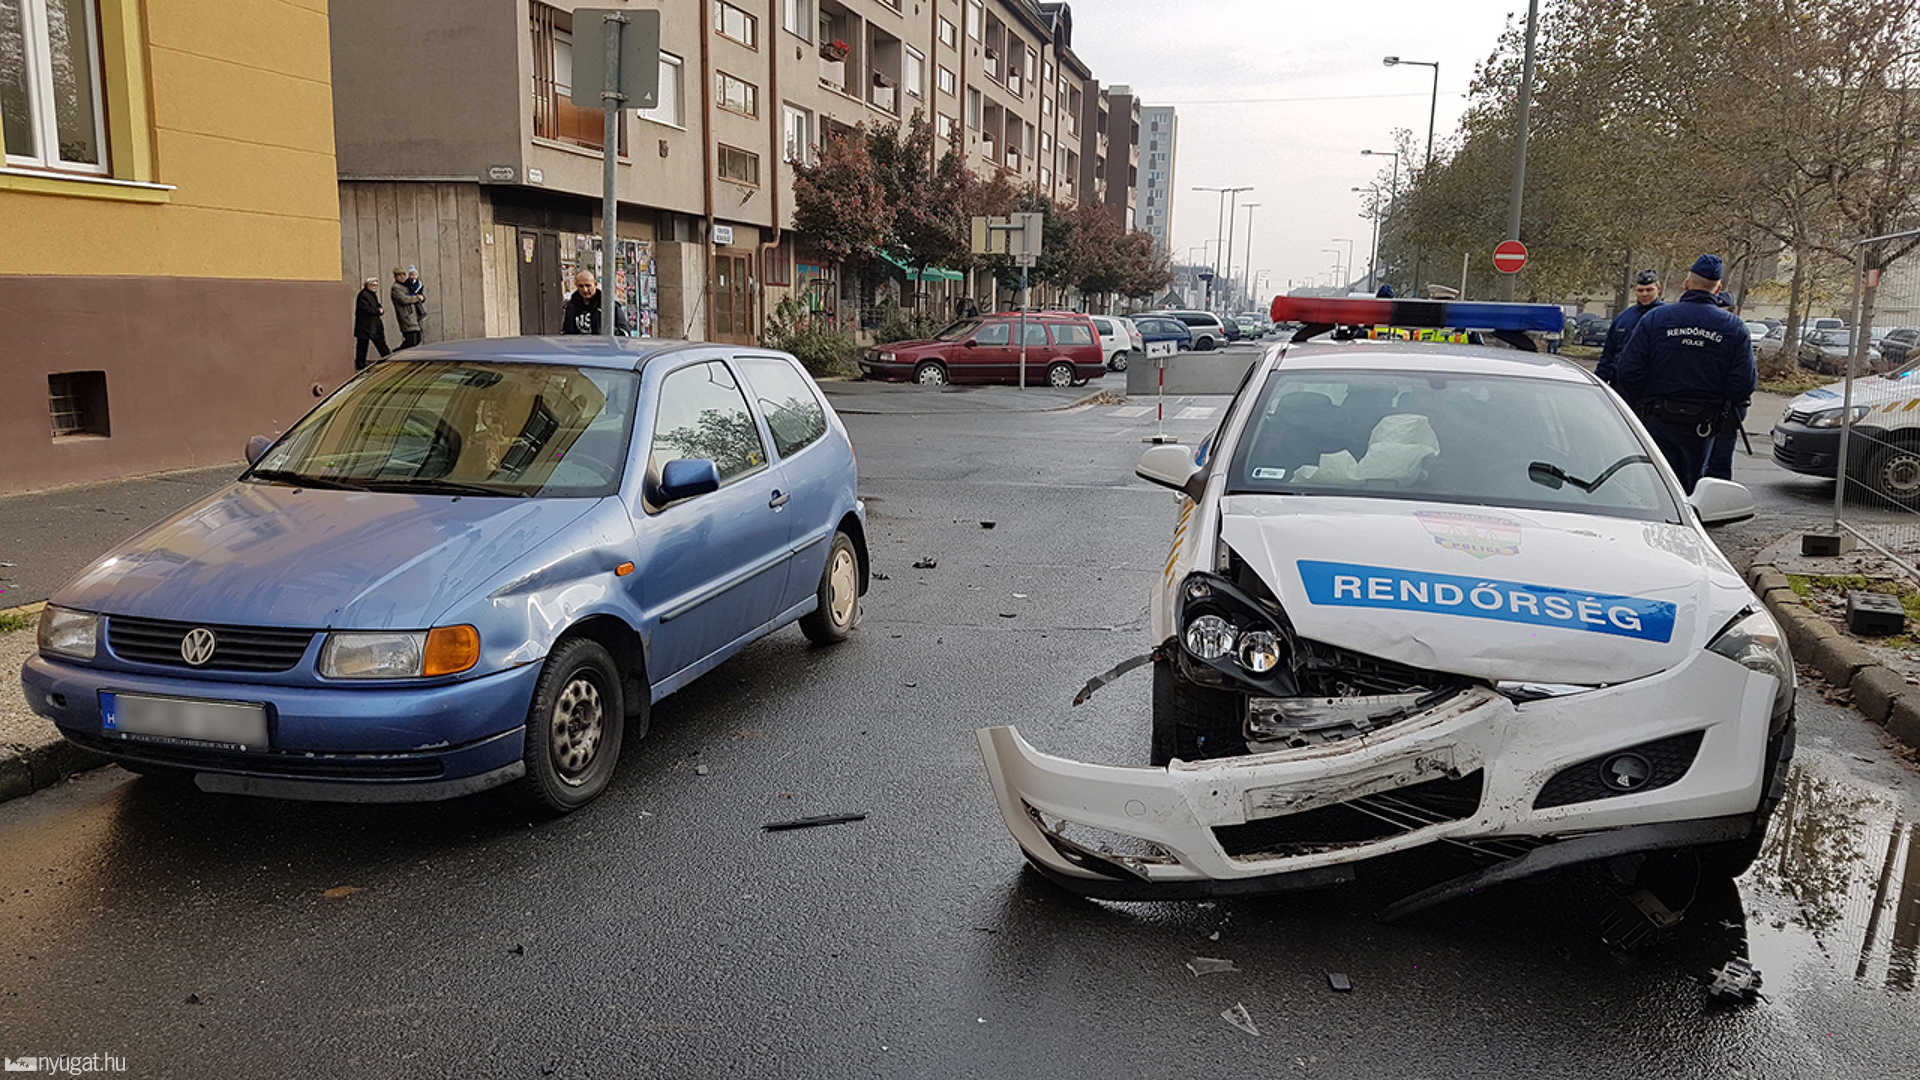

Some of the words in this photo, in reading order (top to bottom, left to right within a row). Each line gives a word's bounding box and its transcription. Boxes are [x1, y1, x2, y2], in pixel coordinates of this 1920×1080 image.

[1681, 338, 1705, 347] POLICE
[1333, 574, 1643, 632] RENDŐRSÉG
[106, 711, 116, 724] H
